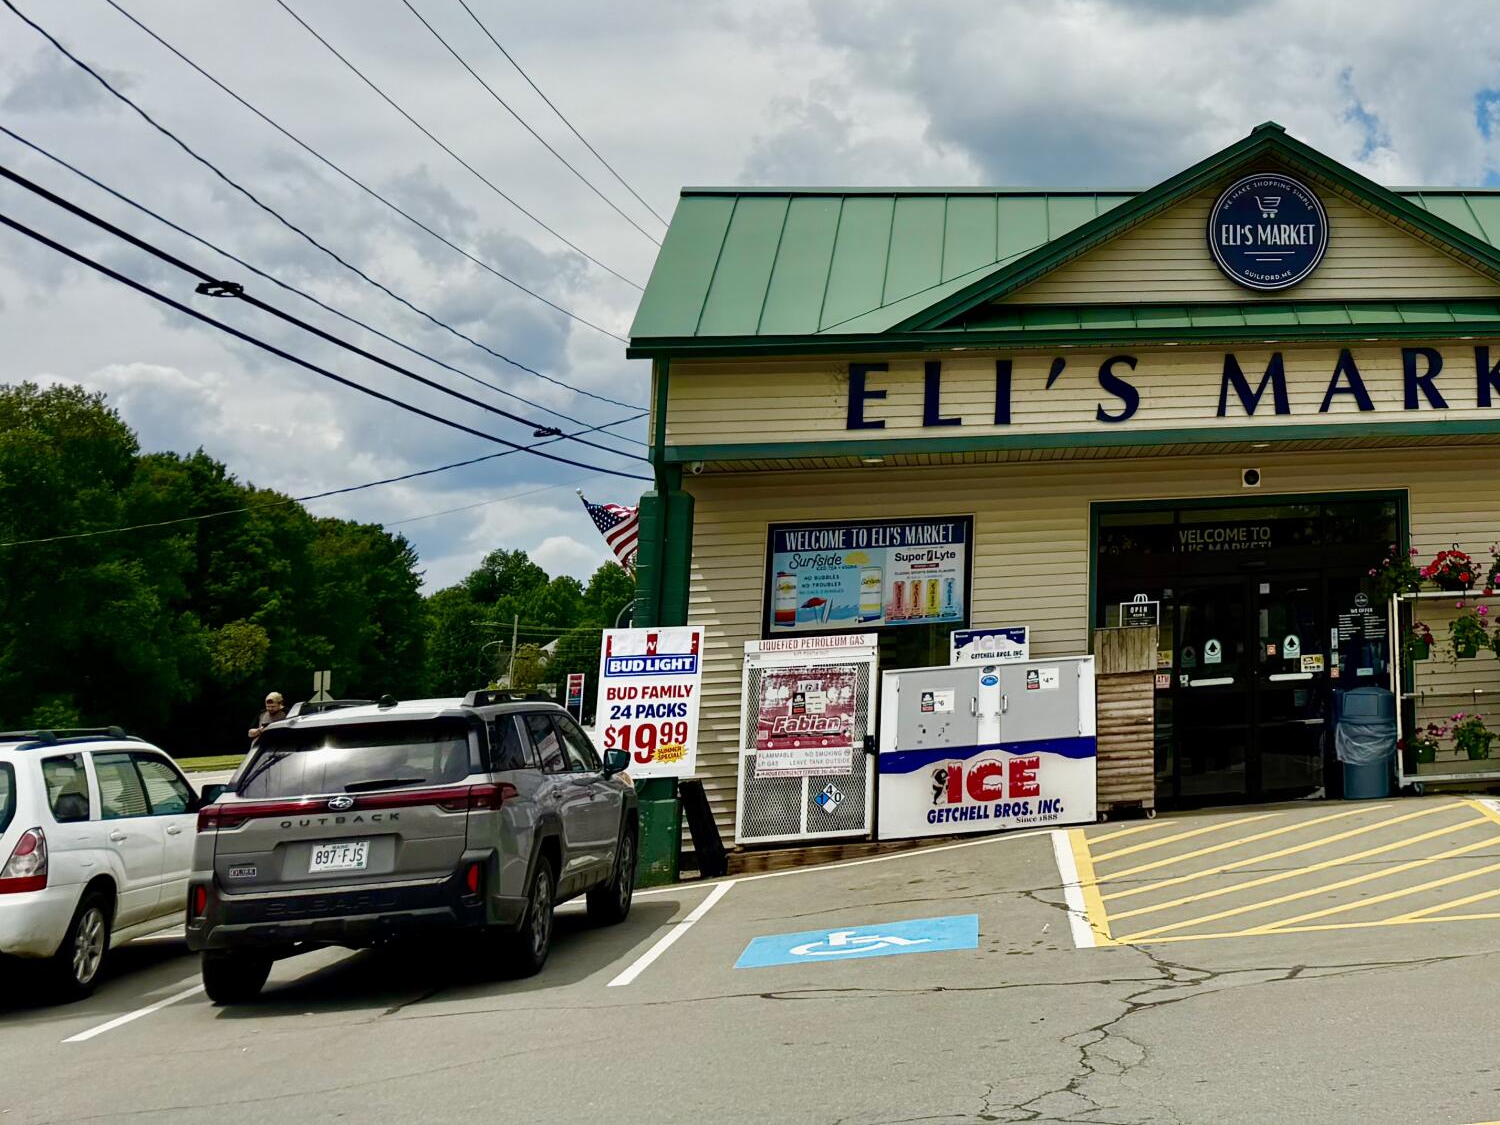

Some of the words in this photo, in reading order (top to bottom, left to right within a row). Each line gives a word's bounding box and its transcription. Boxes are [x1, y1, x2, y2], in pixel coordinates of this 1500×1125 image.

[1223, 200, 1233, 210] WE
[1232, 184, 1251, 199] MAKE
[1253, 180, 1291, 191] SHOPPING
[1292, 187, 1313, 211] SIMPLE
[1221, 224, 1253, 246] ELI'S
[1257, 224, 1315, 245] MARKET
[846, 355, 1140, 430] ELI'S
[785, 529, 846, 551] WELCOME
[851, 529, 867, 548] TO
[872, 527, 900, 547] ELI'S
[905, 524, 955, 545] MARKET
[1250, 526, 1271, 541] TO
[789, 552, 842, 570] Surfside
[894, 552, 925, 563] Super
[934, 550, 956, 561] Lyte
[759, 639, 798, 651] LIQUEFIED
[801, 636, 847, 649] PETROLEUM
[849, 635, 865, 646] GAS
[610, 659, 645, 673] BUD
[645, 658, 693, 672] LIGHT
[1156, 675, 1169, 683] ATM
[606, 686, 638, 701] BUD
[641, 684, 694, 700] FAMILY
[610, 704, 632, 720] 24
[635, 703, 687, 719] PACKS
[772, 714, 841, 734] Fabian
[947, 755, 1040, 804] ICE
[819, 793, 825, 804] 1
[835, 792, 841, 803] 0
[826, 784, 833, 795] 4
[927, 804, 990, 825] GETCHELL
[994, 801, 1034, 817] BROS.
[1037, 797, 1064, 814] INC.
[1016, 815, 1037, 823] Since
[1039, 814, 1058, 822] 1888
[280, 812, 400, 829] OUTBACK
